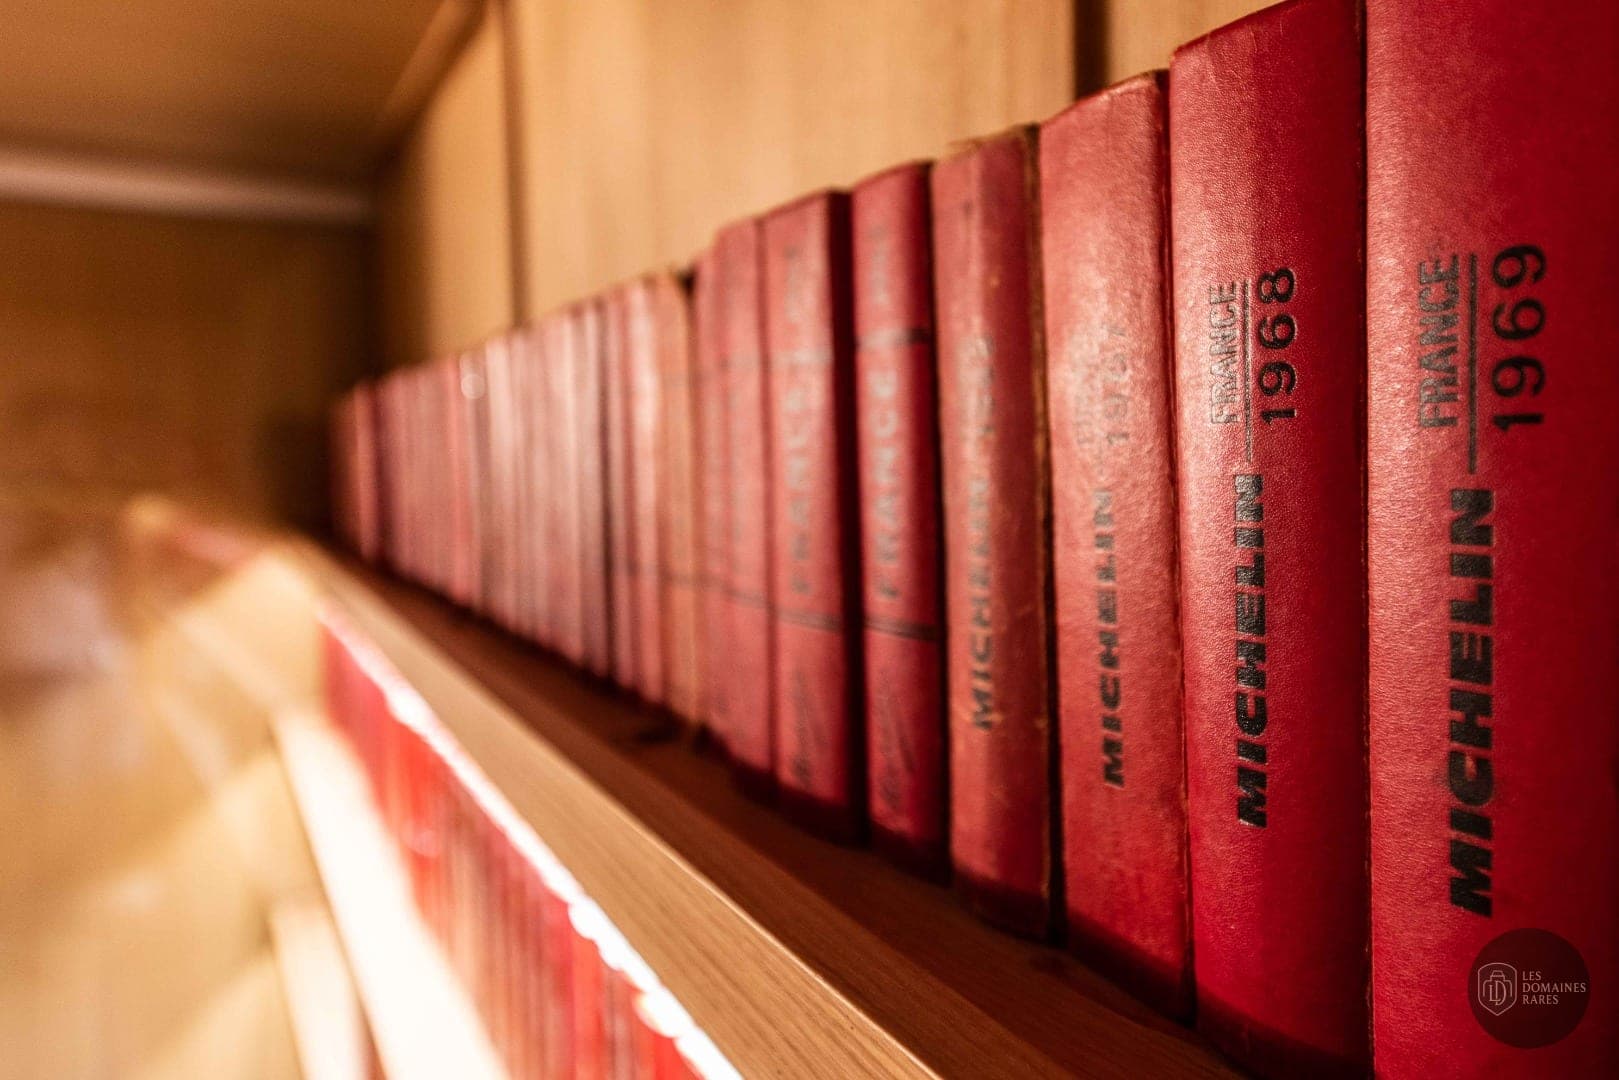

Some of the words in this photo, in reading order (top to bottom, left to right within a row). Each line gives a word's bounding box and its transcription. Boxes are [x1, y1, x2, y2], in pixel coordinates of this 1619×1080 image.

[1208, 282, 1239, 426] FRANCE
[1257, 266, 1298, 425] 1968
[1417, 252, 1459, 428] FRANCE
[1492, 244, 1546, 430] 1969
[966, 479, 995, 732] MICHELIN
[1092, 490, 1124, 788] MICHELIN
[1234, 473, 1269, 828] MICHELIN
[1448, 488, 1494, 918] MICHELIN
